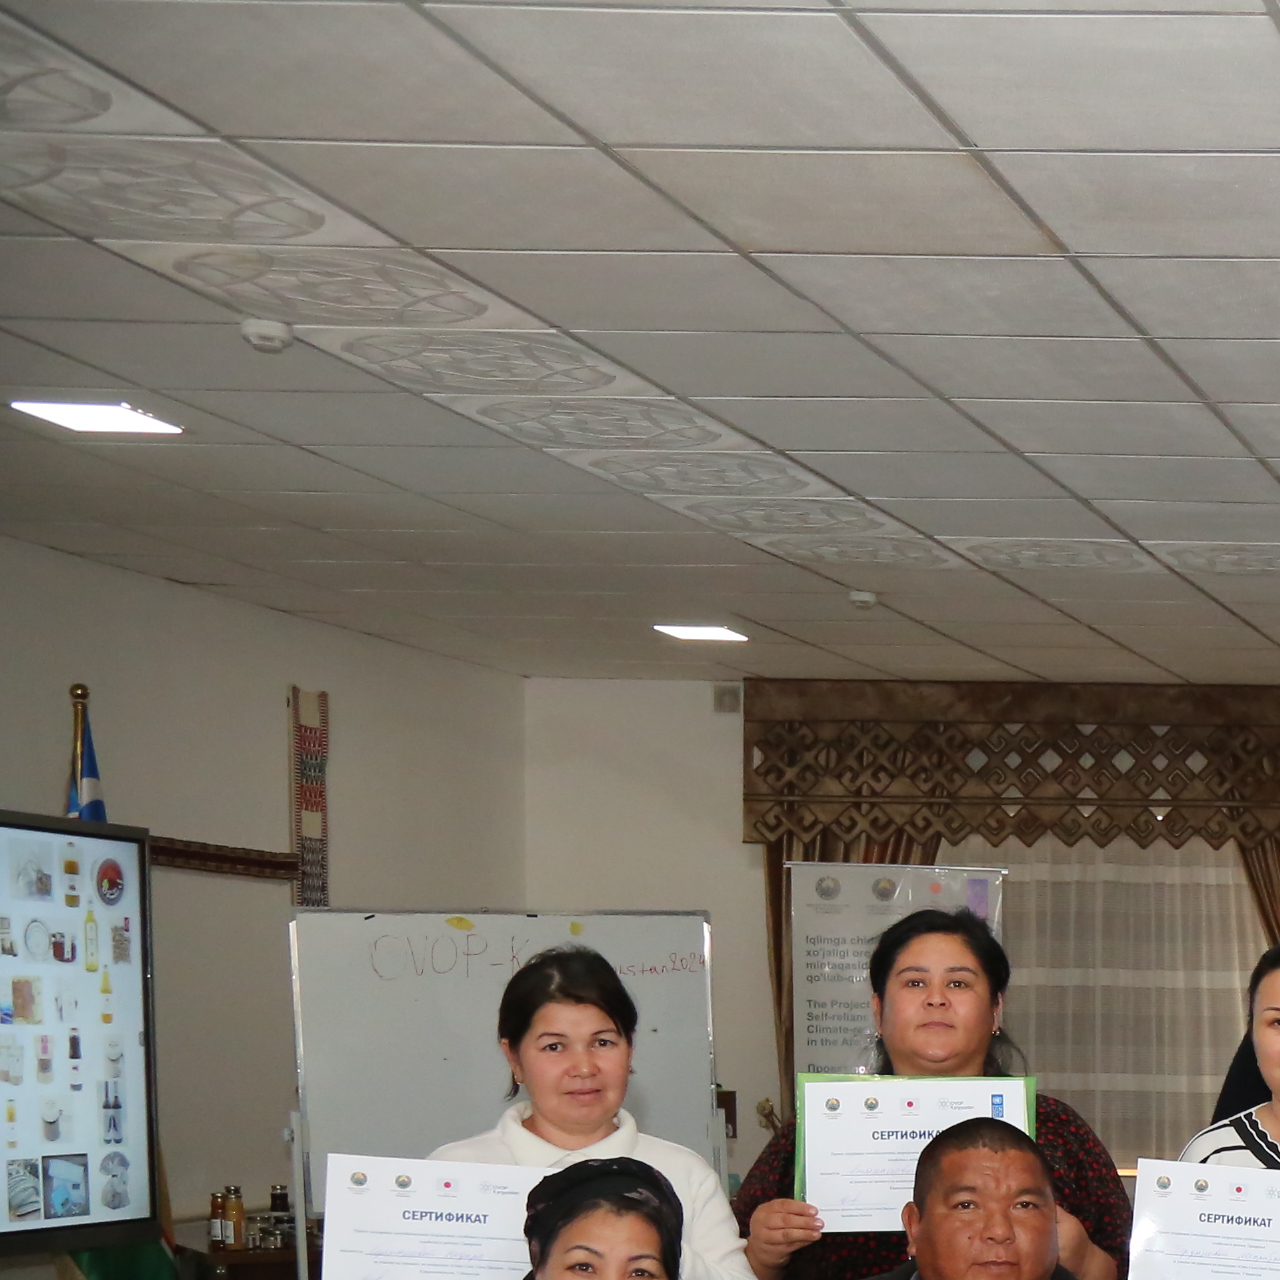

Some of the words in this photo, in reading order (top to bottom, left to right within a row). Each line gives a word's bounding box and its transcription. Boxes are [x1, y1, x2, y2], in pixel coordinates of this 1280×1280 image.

[806, 935, 847, 947] Iqlimga
[806, 999, 827, 1009] The
[830, 999, 870, 1011] Project
[807, 1037, 817, 1047] in
[820, 1037, 838, 1047] the
[402, 1209, 490, 1225] СЕРТИФИКАТ
[1199, 1212, 1273, 1228] СЕРТИФИКАТ
